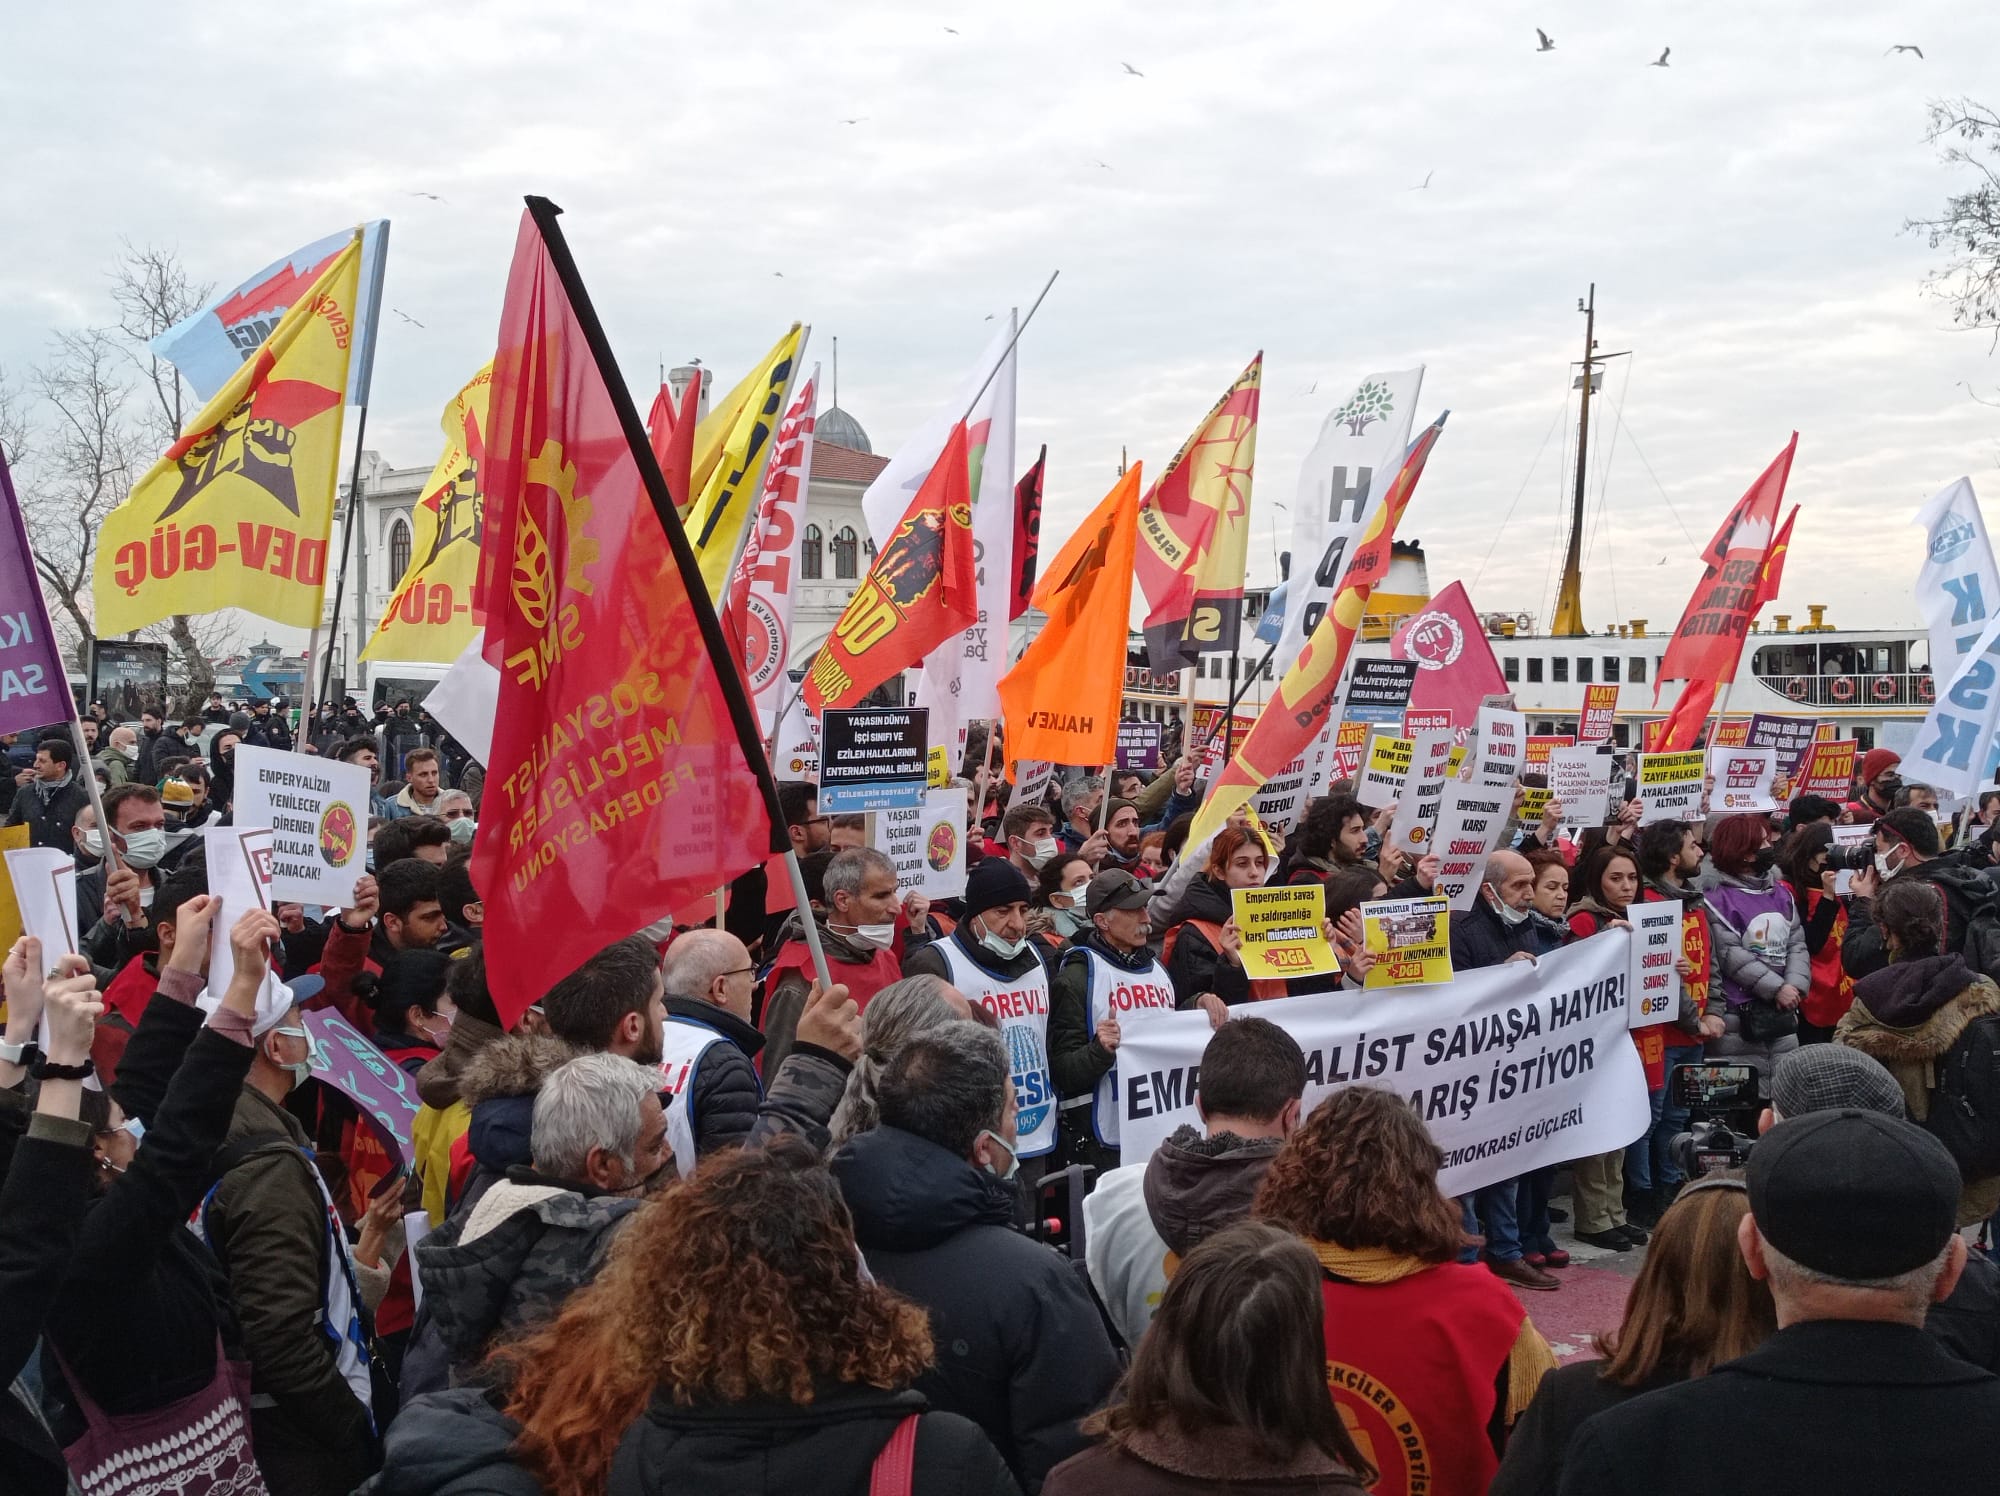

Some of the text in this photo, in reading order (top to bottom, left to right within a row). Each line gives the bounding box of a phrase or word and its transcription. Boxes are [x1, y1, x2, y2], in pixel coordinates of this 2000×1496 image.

[1367, 664, 1406, 674] KAHROLSUN
[1352, 676, 1389, 687] MİLLİYETÇİ
[1351, 690, 1383, 700] UKRAYNA
[1589, 686, 1617, 700] NATO
[848, 713, 910, 728] YAŞASIN DÜNYA
[1757, 721, 1781, 734] SAVAŞ
[893, 732, 903, 740] VE
[1491, 721, 1515, 738] RUSYA
[1753, 732, 1776, 747] ÖLÜM
[837, 748, 917, 760] EZİLEN HALKLARININ
[1375, 749, 1395, 761] TÜM
[1488, 743, 1516, 758] ve NATO
[1557, 761, 1587, 770] YAŞASIN
[1643, 755, 1682, 767] EMPERYALİST
[1730, 761, 1745, 774] Say
[1811, 756, 1852, 778] NATO
[826, 764, 896, 776] ENTERNASYONAL
[1557, 771, 1590, 779] UKRAYNA
[1644, 769, 1701, 783] ZAYIF HALKASI
[259, 768, 331, 794] EMPERYALİZM
[1367, 773, 1394, 785] DÜNYA
[1557, 777, 1609, 788] HALKININ KENDİ
[1728, 777, 1756, 787] to war!
[1557, 787, 1606, 796] KADERİNİ TAYİN
[1641, 783, 1702, 798] AYAKLARIMIZIN
[269, 792, 321, 814] YENİLECEK
[1258, 796, 1295, 814] DEFOL!
[1456, 799, 1500, 814] EMPERYALİZME
[1655, 797, 1688, 808] ALTINDA
[888, 809, 919, 824] YAŞASIN
[273, 814, 315, 835] DİRENEN
[1462, 819, 1488, 835] KARŞI
[886, 824, 922, 841] İŞÇİLERİN
[890, 841, 917, 855] BİRLİĞİ
[1449, 839, 1486, 855] SÜREKLİ
[272, 861, 321, 881] ZANACAK!
[896, 859, 922, 872] KLARIN
[1440, 862, 1474, 877] SAVAŞ!
[896, 875, 925, 889] DEŞLİĞİ!
[1245, 890, 1315, 905] Emperyalist savaş
[1444, 884, 1465, 898] SEP
[1249, 908, 1311, 923] ve saldırganlığa
[1365, 904, 1410, 916] EMPERYALİSTLER
[1641, 914, 1674, 928] EMPERYALİZME
[1245, 931, 1265, 943] karşı
[1648, 932, 1668, 947] KARŞI
[1277, 949, 1307, 965] DGB
[1404, 946, 1446, 961] UNUTMAYIN!
[1642, 949, 1672, 969] SÜREKLİ
[1399, 963, 1421, 977] DGB
[1643, 973, 1669, 991] SAVAŞ!
[981, 985, 1049, 1019] ÖREVLİ
[1651, 995, 1669, 1013] SEP
[1423, 1003, 1541, 1066] SAVAŞA
[1549, 972, 1626, 1032] HAYIR!
[1407, 1075, 1481, 1121] ARIŞ
[1488, 1037, 1595, 1104] İSTİYOR
[1437, 1102, 1584, 1171] EMOKRASİ GÜÇLERİ
[1326, 1366, 1396, 1414] EKÇİLER
